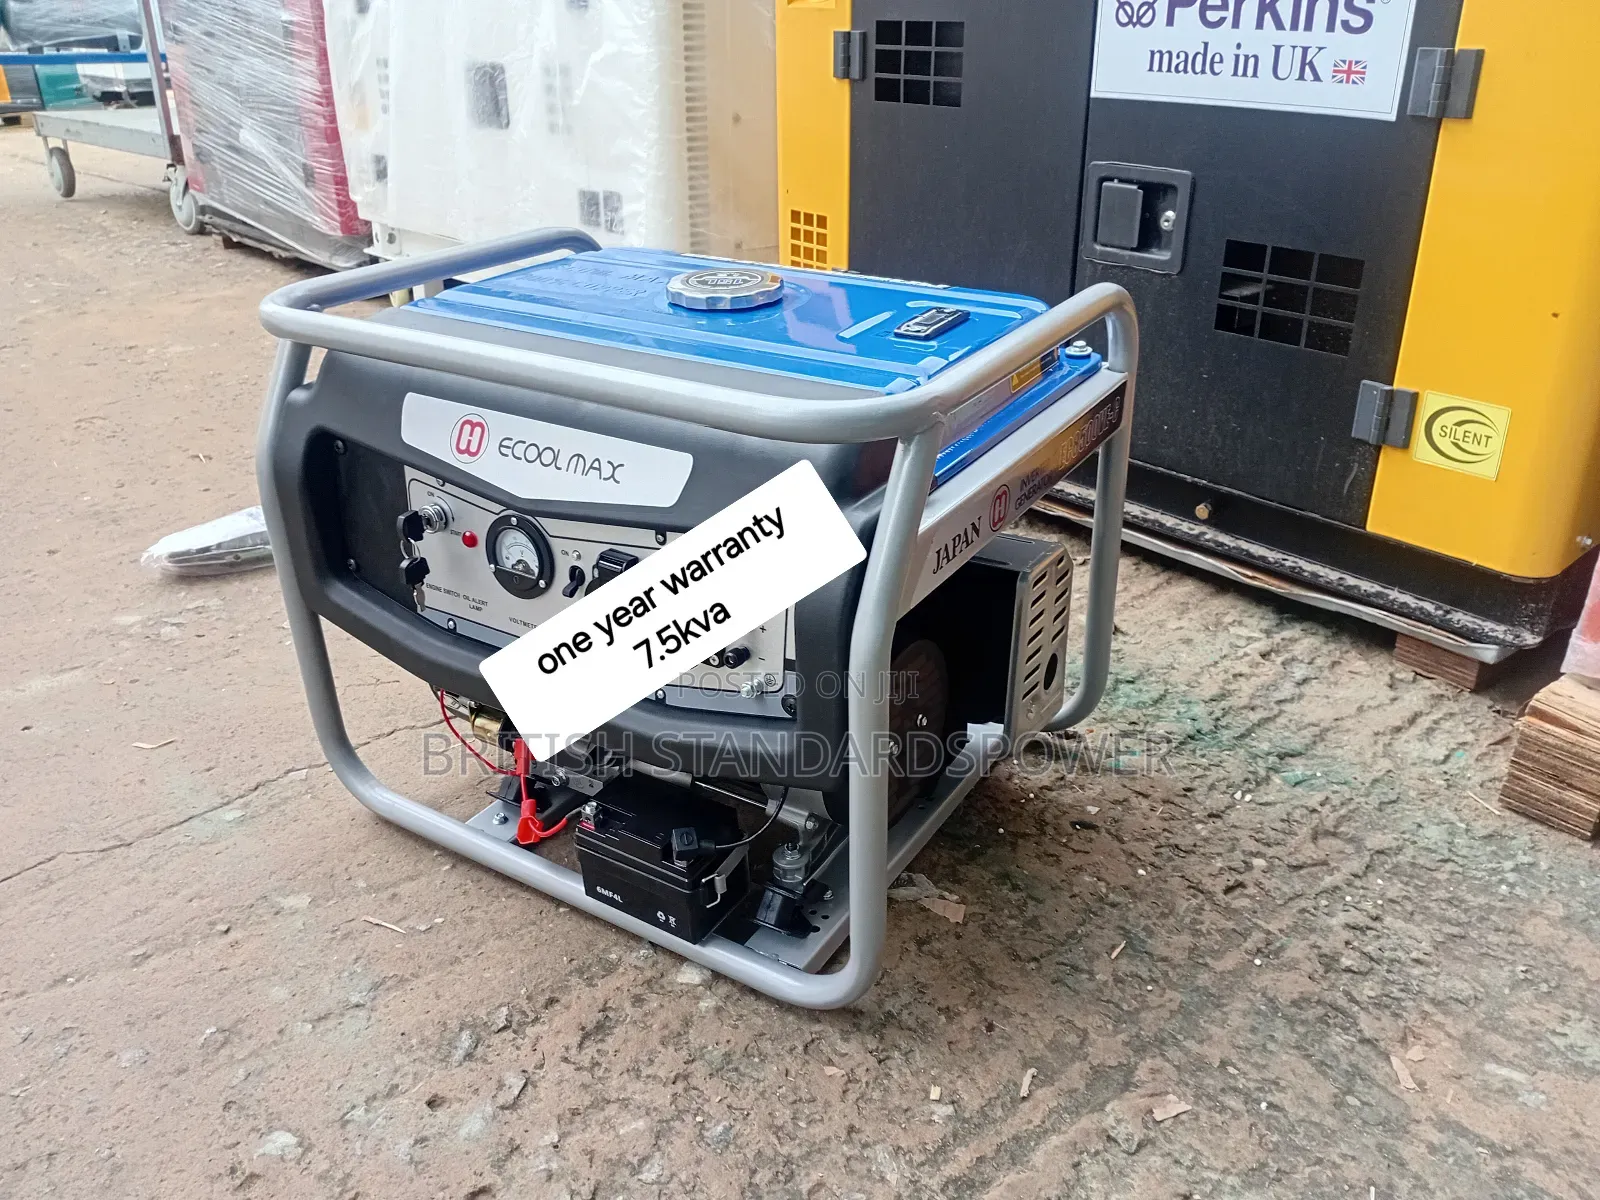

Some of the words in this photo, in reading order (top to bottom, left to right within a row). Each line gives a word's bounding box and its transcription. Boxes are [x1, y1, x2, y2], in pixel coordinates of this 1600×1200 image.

[1147, 41, 1224, 77] made
[1230, 42, 1260, 78] in
[1271, 44, 1327, 83] UK
[1438, 424, 1493, 448] SILENT
[932, 515, 983, 574] JAPAN
[426, 582, 443, 593] ENGINE
[443, 588, 460, 598] SWITCH
[462, 594, 471, 602] OIL
[472, 598, 488, 607] ALERT
[469, 604, 483, 612] LAMP
[509, 616, 538, 629] VOLTMETE
[596, 885, 623, 903] 6MF4L
